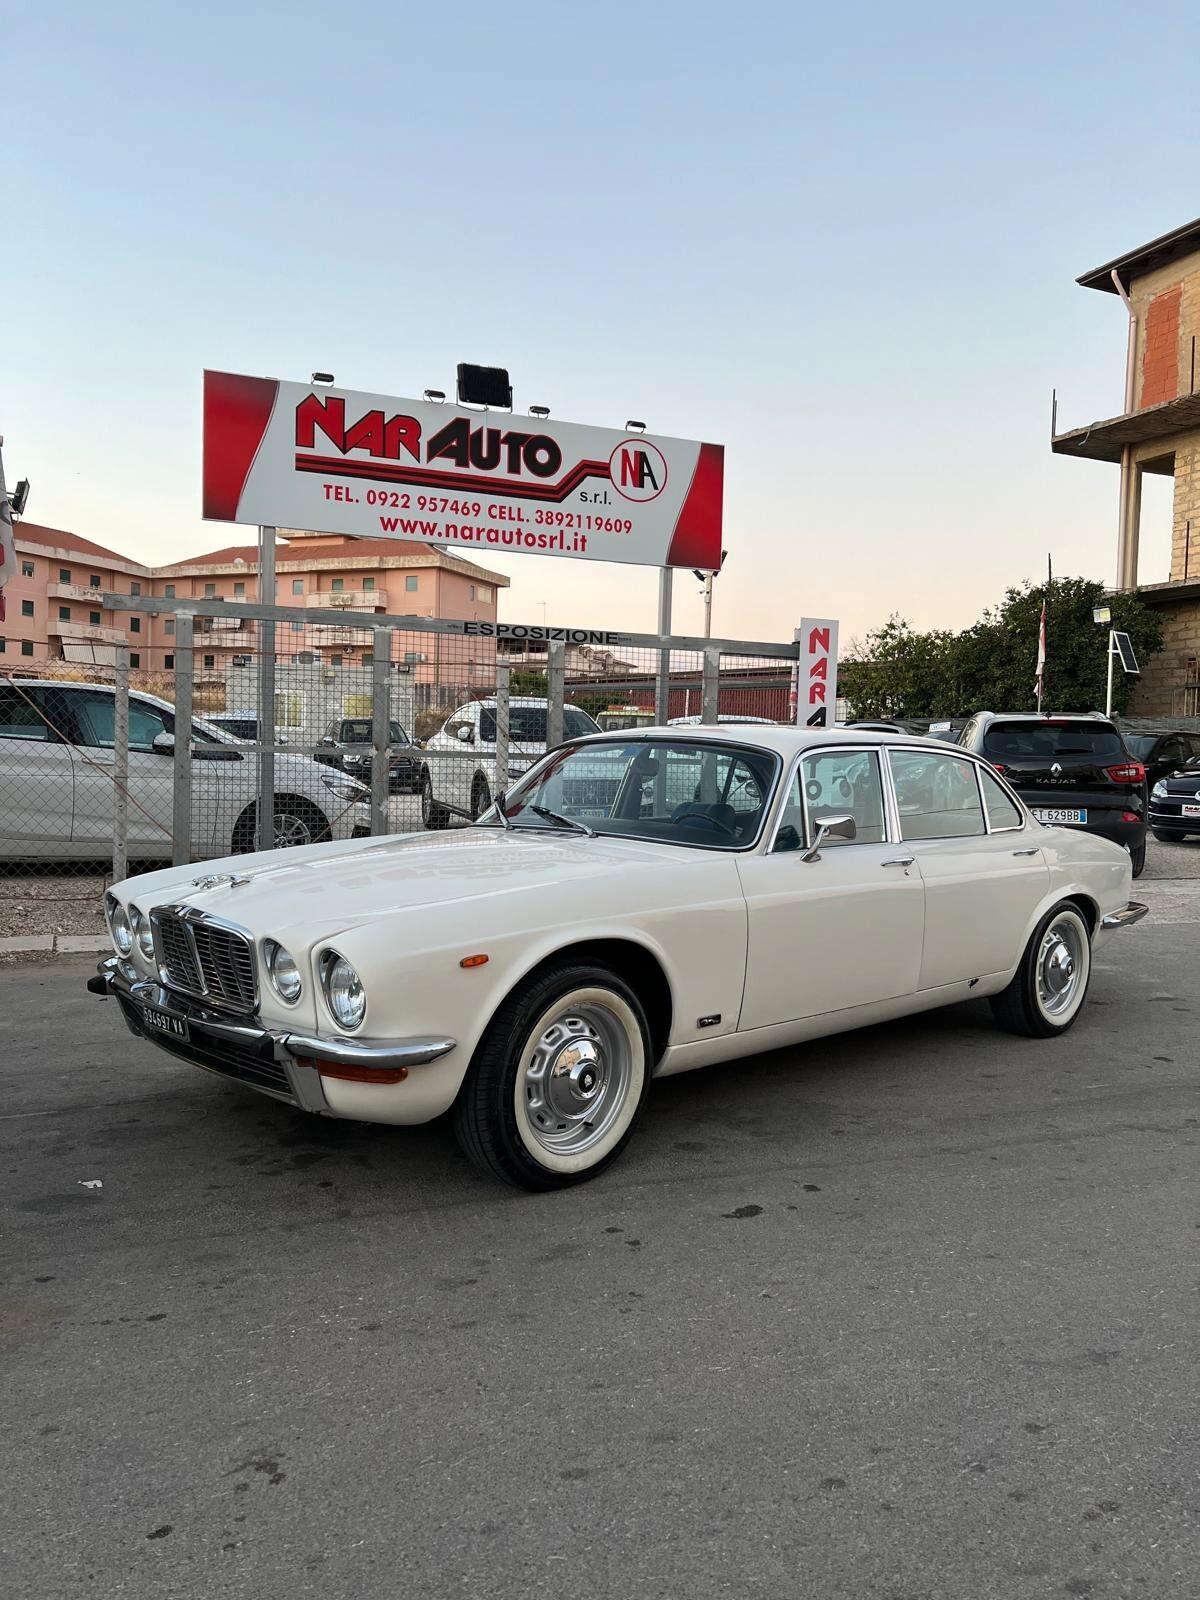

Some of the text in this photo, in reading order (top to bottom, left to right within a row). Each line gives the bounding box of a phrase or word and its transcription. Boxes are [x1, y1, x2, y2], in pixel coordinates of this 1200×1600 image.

[295, 392, 562, 478] NAR AUTO
[620, 448, 659, 491] NA
[323, 484, 633, 534] TEL. 0922 957469 CELL. 3892119609
[579, 490, 612, 505] s.r.l.
[379, 516, 588, 552] www.narautosrl.it
[463, 621, 619, 645] ESPOSIZIONE
[1047, 810, 1080, 821] 629BB
